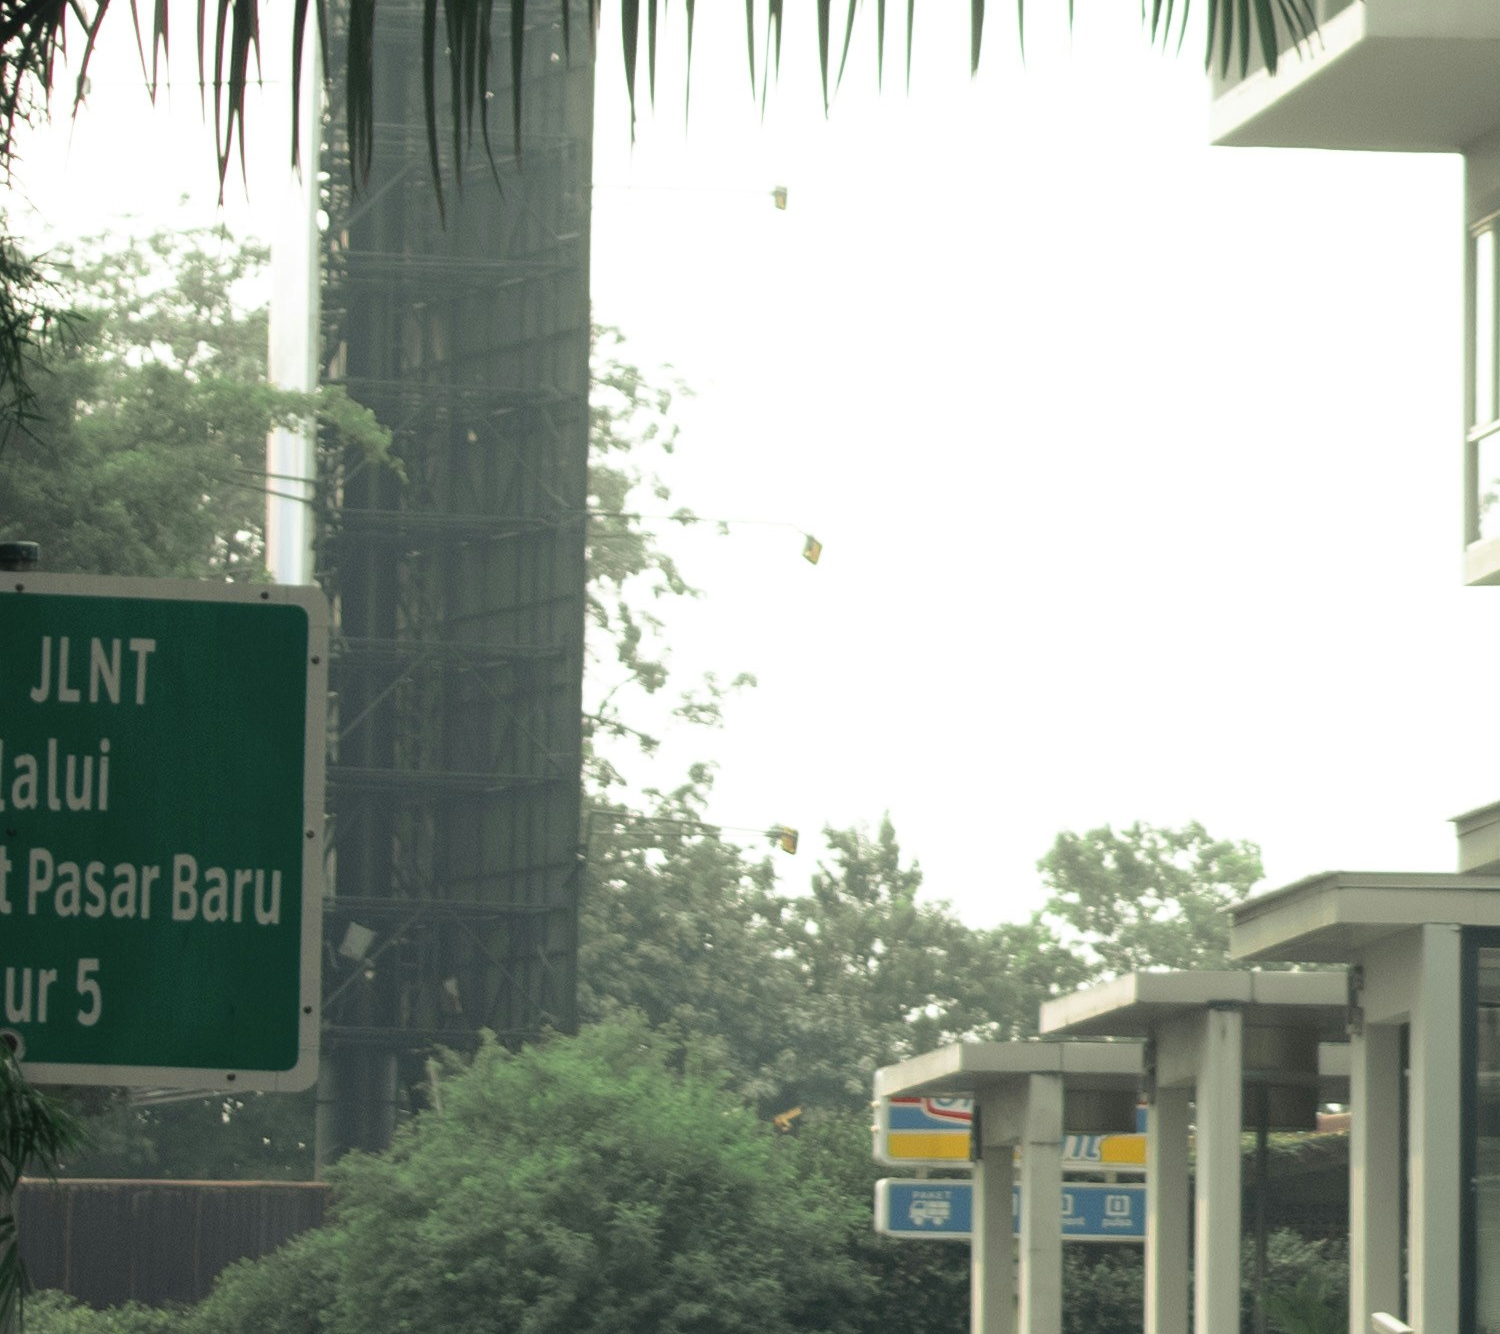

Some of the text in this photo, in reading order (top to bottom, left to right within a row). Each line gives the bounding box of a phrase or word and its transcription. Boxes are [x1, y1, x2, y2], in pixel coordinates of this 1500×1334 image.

[30, 636, 156, 705] JLNT
[27, 847, 160, 919] Pasar
[171, 853, 282, 925] Baru
[76, 957, 102, 1026] 5
